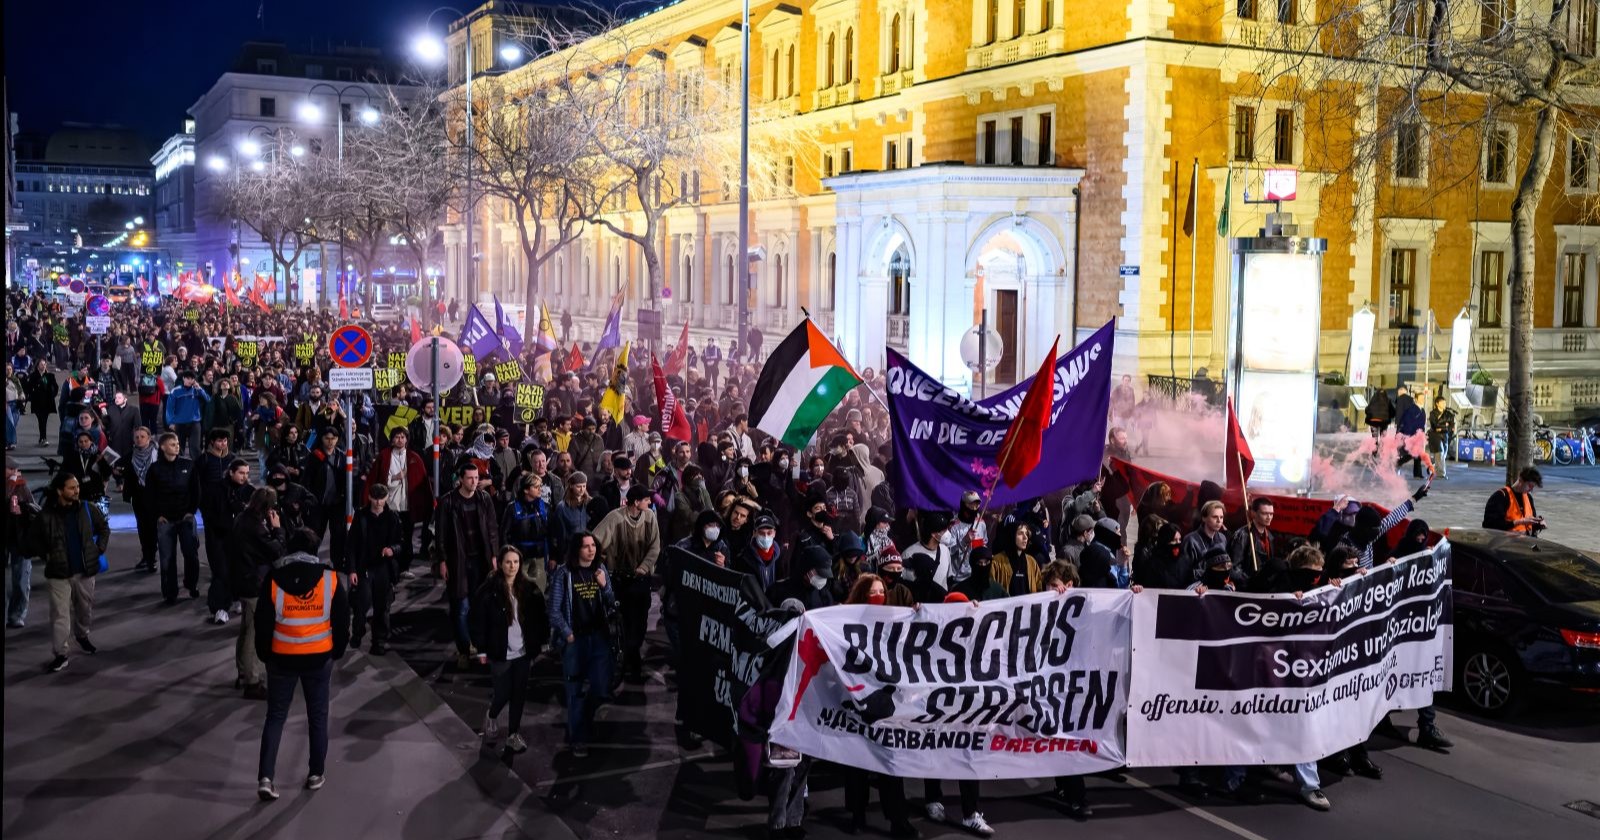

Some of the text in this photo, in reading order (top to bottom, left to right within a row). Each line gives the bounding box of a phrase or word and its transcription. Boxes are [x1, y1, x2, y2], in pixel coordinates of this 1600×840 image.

[388, 353, 407, 361] NAZI
[388, 360, 406, 369] RAU
[463, 354, 476, 362] AZIS
[495, 360, 519, 373] NAZIS
[499, 369, 521, 382] RAUS
[516, 394, 545, 408] RAUS
[517, 384, 545, 397] NAZIS
[910, 418, 934, 440] IN
[937, 421, 971, 445] DIE
[681, 569, 702, 592] DEN
[1234, 594, 1363, 627] Gemeinsam
[1364, 574, 1405, 613] gegen
[842, 595, 1086, 684] BURSCHIS
[1273, 642, 1359, 679] Sexismus
[911, 670, 1118, 736] STRESSEN
[1141, 693, 1224, 721] offensiv.
[817, 707, 1098, 754] NAZIVERBÄNDE BRECHEN
